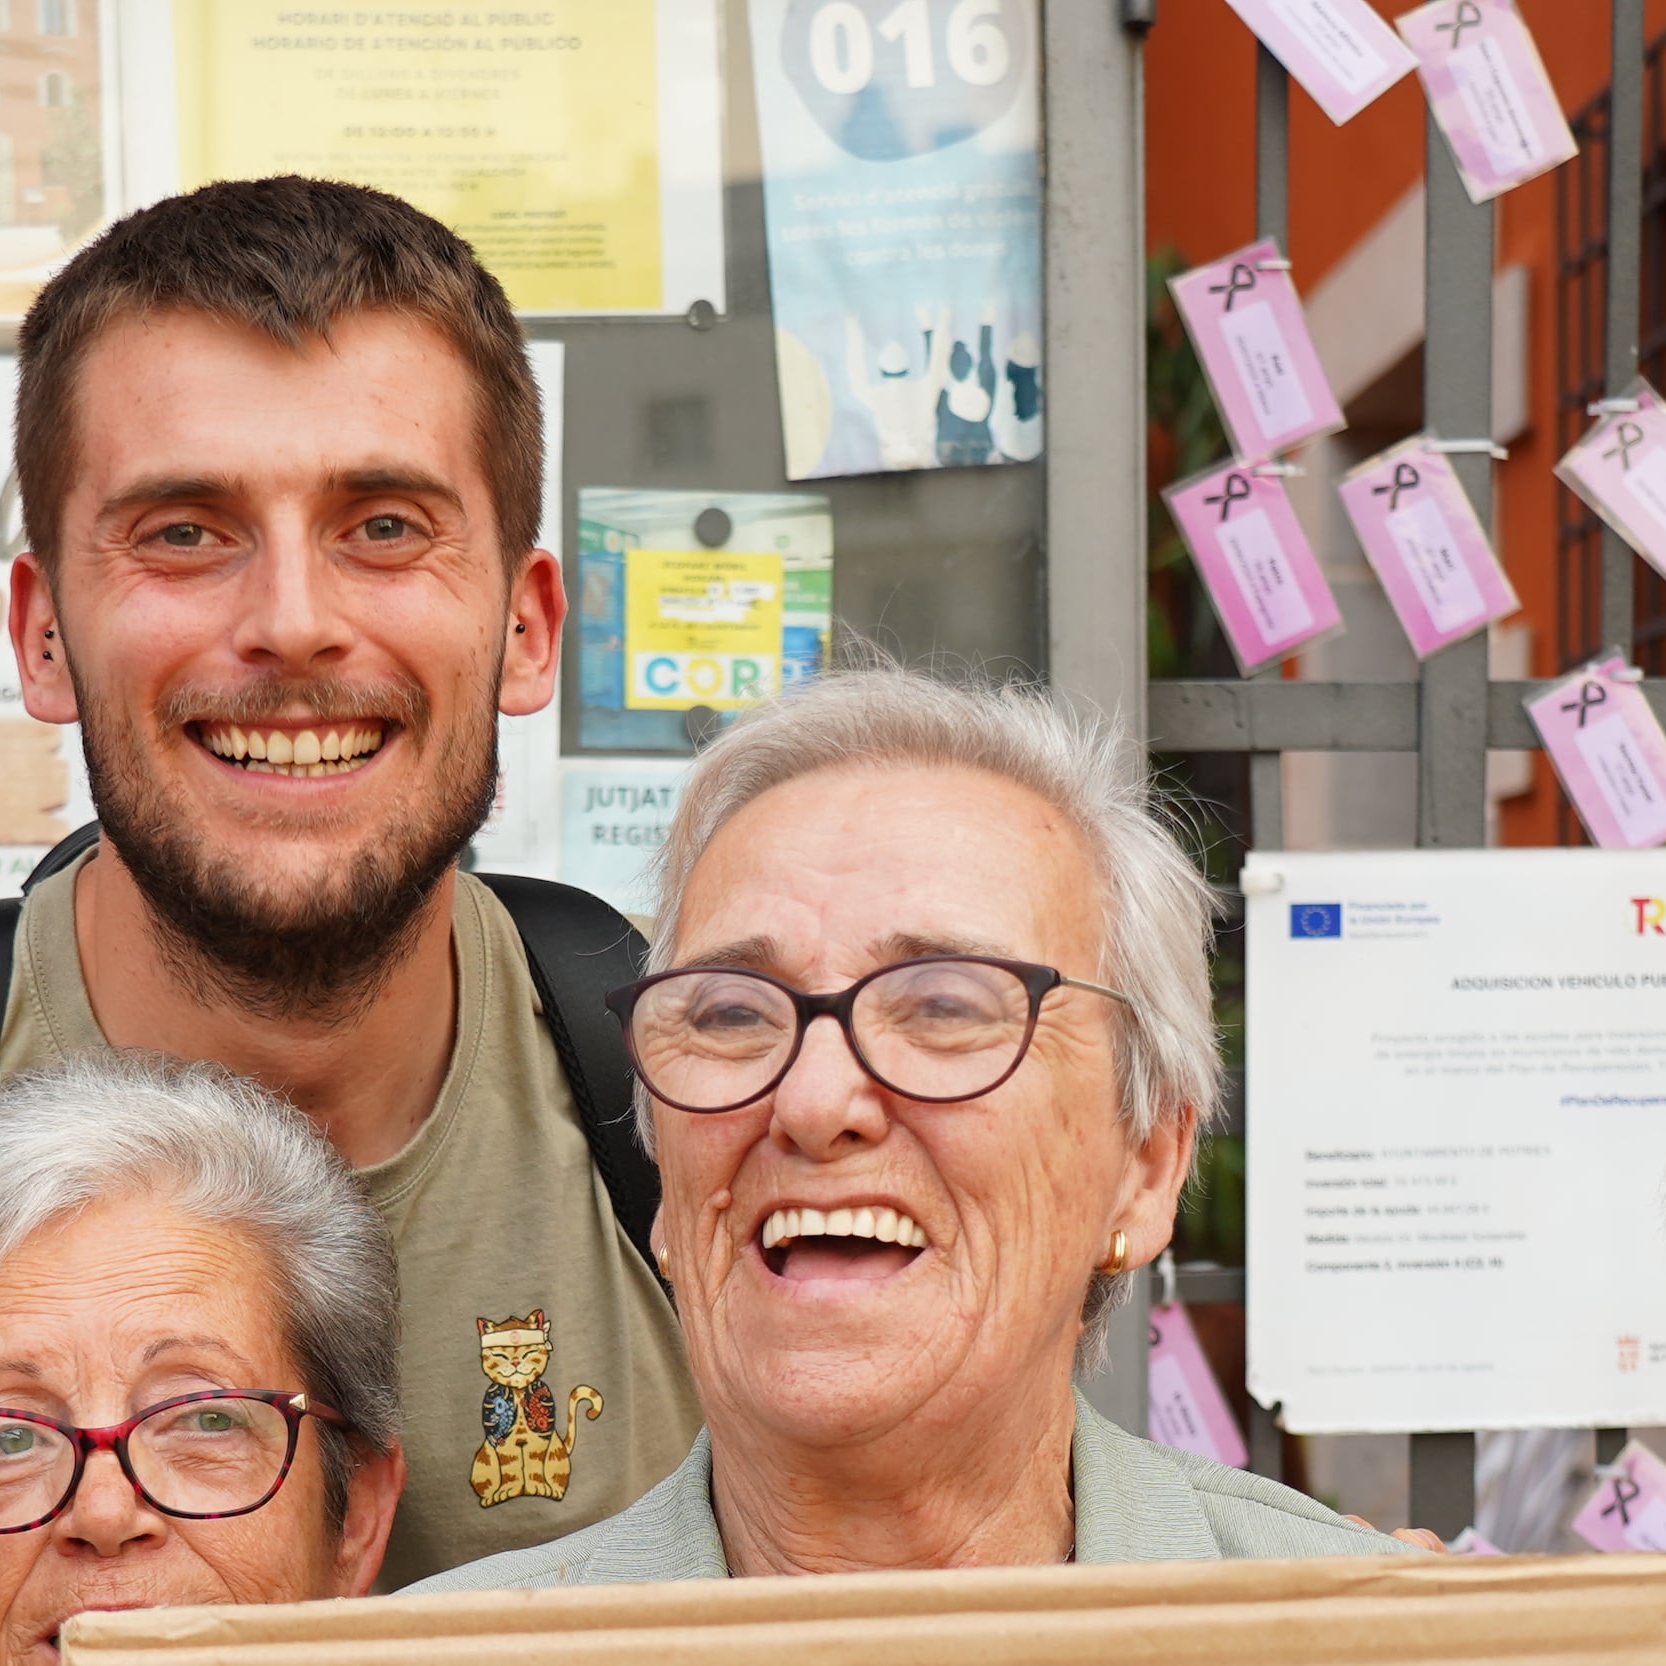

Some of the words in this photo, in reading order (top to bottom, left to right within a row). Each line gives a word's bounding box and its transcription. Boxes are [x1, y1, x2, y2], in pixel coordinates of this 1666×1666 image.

[277, 11, 350, 27] HORARI
[461, 12, 483, 27] AL
[486, 9, 555, 27] PÚBLIC
[251, 35, 338, 51] HORARIO
[344, 36, 367, 51] DE
[372, 33, 469, 51] ATENCIÓN
[474, 36, 495, 51] AL
[500, 33, 583, 51] PÚBLICO
[808, 0, 1011, 95] 016
[645, 656, 762, 700] COR
[584, 785, 673, 814] JUTJAT
[591, 823, 671, 847] REGIS
[1451, 974, 1553, 992] ADQUISICION
[1557, 974, 1637, 991] VEHICULO
